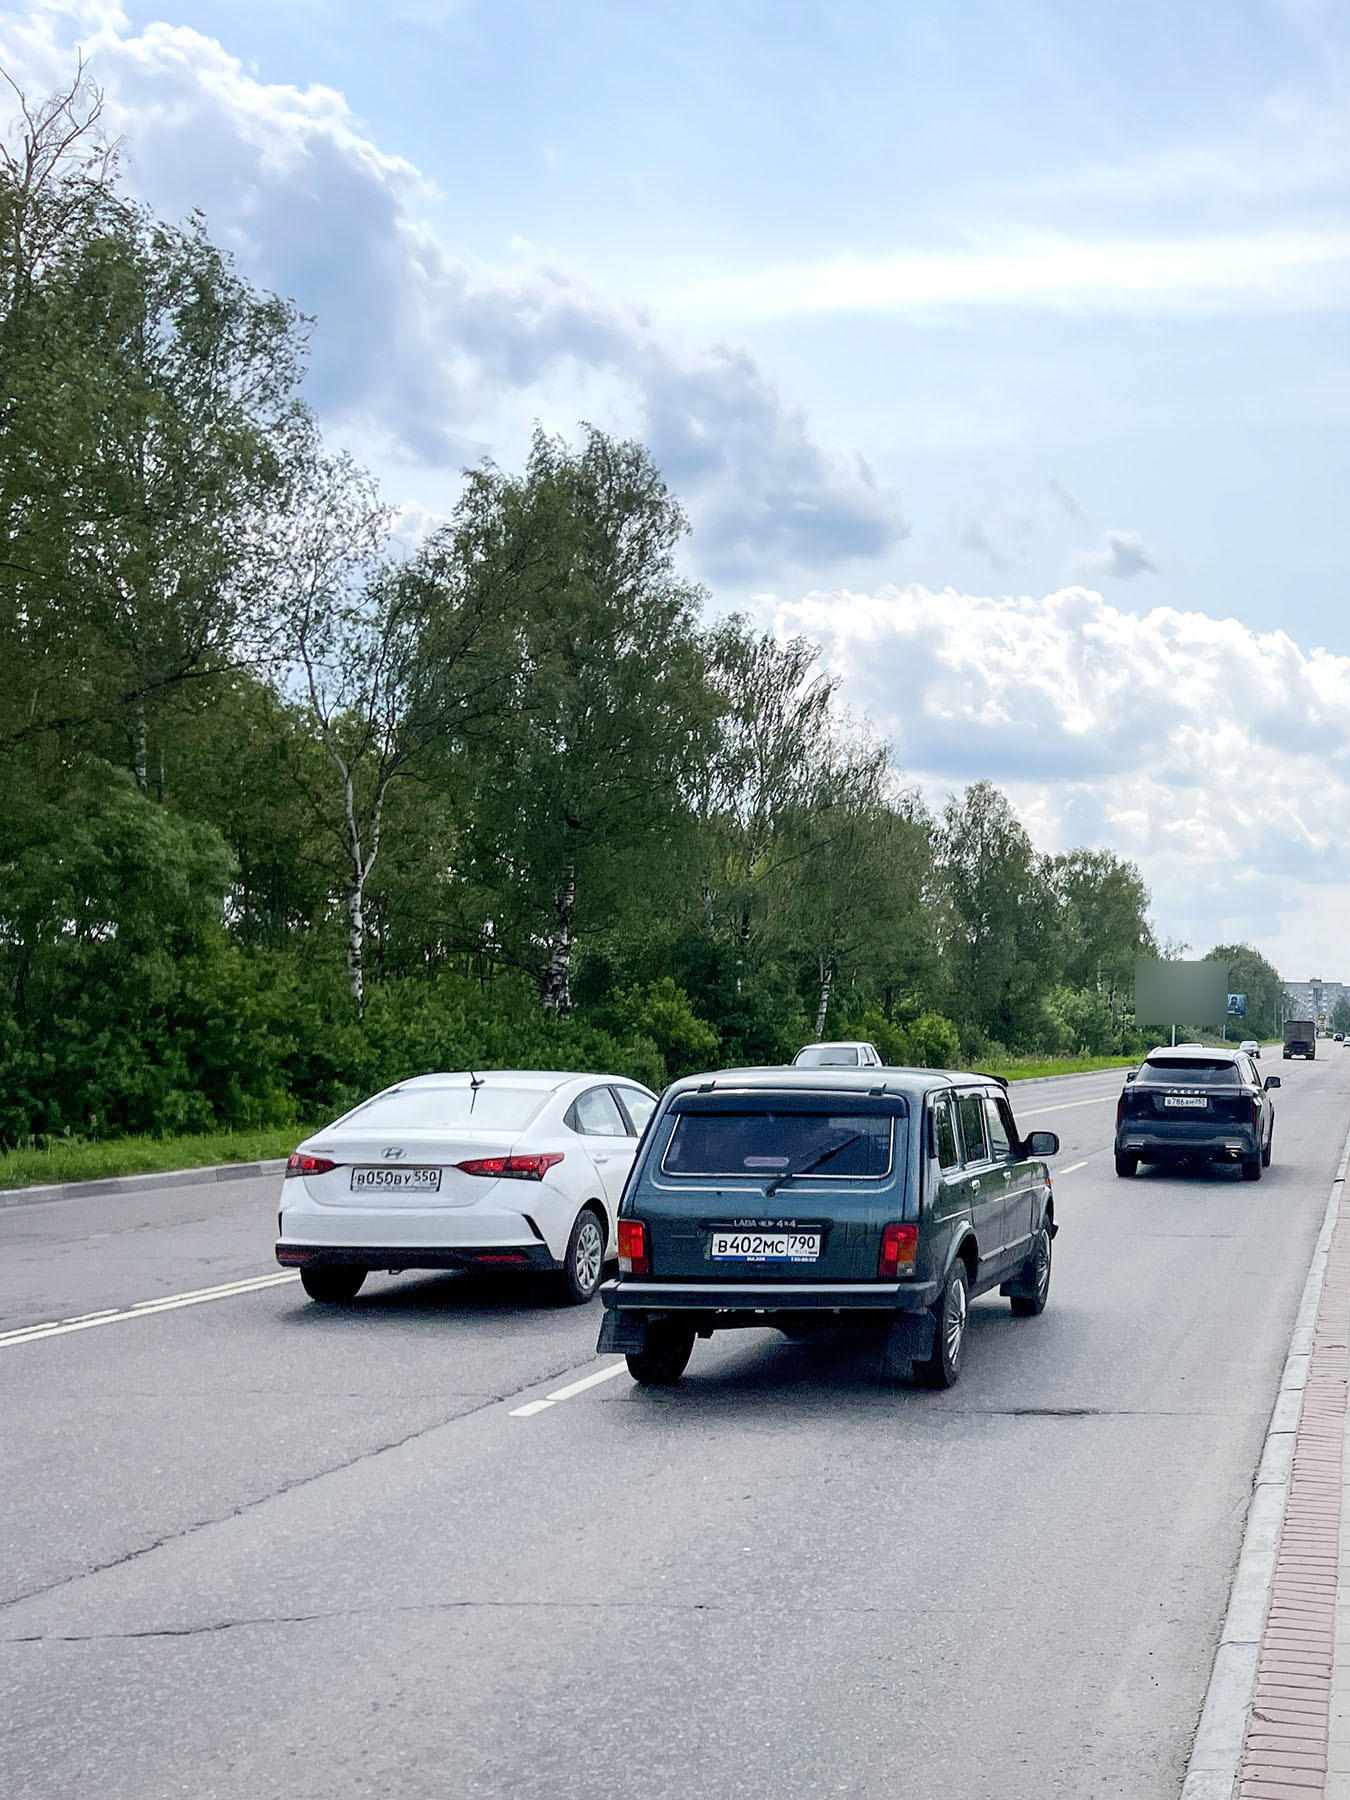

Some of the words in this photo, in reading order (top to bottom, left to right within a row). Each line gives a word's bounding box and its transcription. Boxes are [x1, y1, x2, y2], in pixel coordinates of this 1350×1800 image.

[414, 1171, 437, 1182] 550
[733, 1219, 757, 1228] LADA
[718, 1236, 785, 1254] В402МС
[789, 1236, 816, 1250] 790
